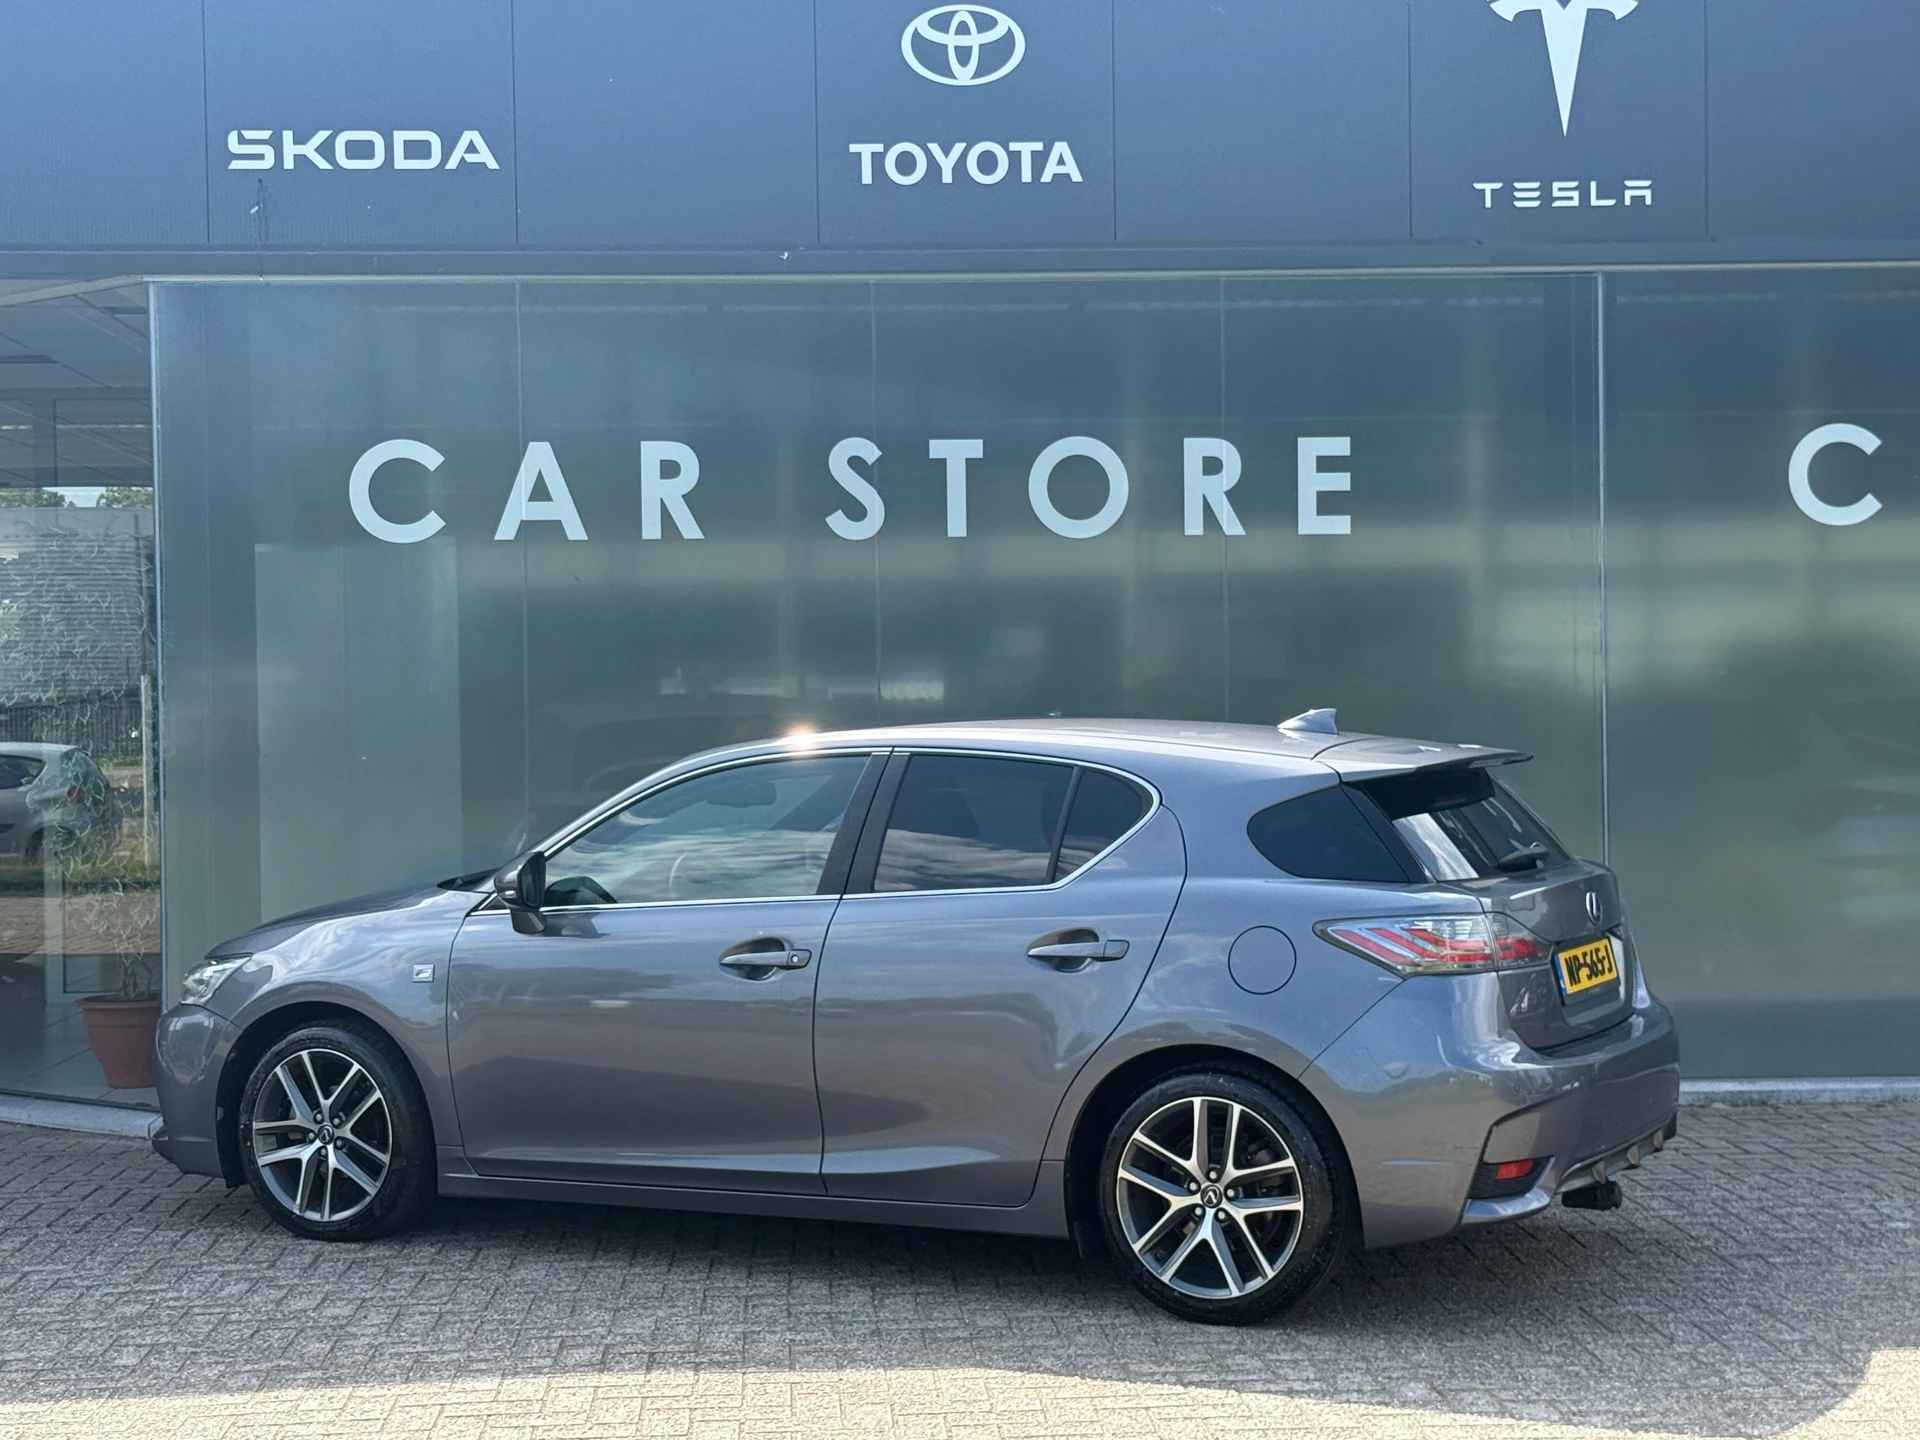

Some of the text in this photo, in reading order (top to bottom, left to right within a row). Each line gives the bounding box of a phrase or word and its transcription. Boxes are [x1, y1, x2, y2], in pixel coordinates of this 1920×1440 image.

[849, 141, 1084, 186] TOYOTA
[1473, 180, 1652, 208] TESLA
[349, 436, 1352, 544] CAR STORE
[1788, 423, 1883, 526] C
[1564, 944, 1614, 987] NP-565-J
